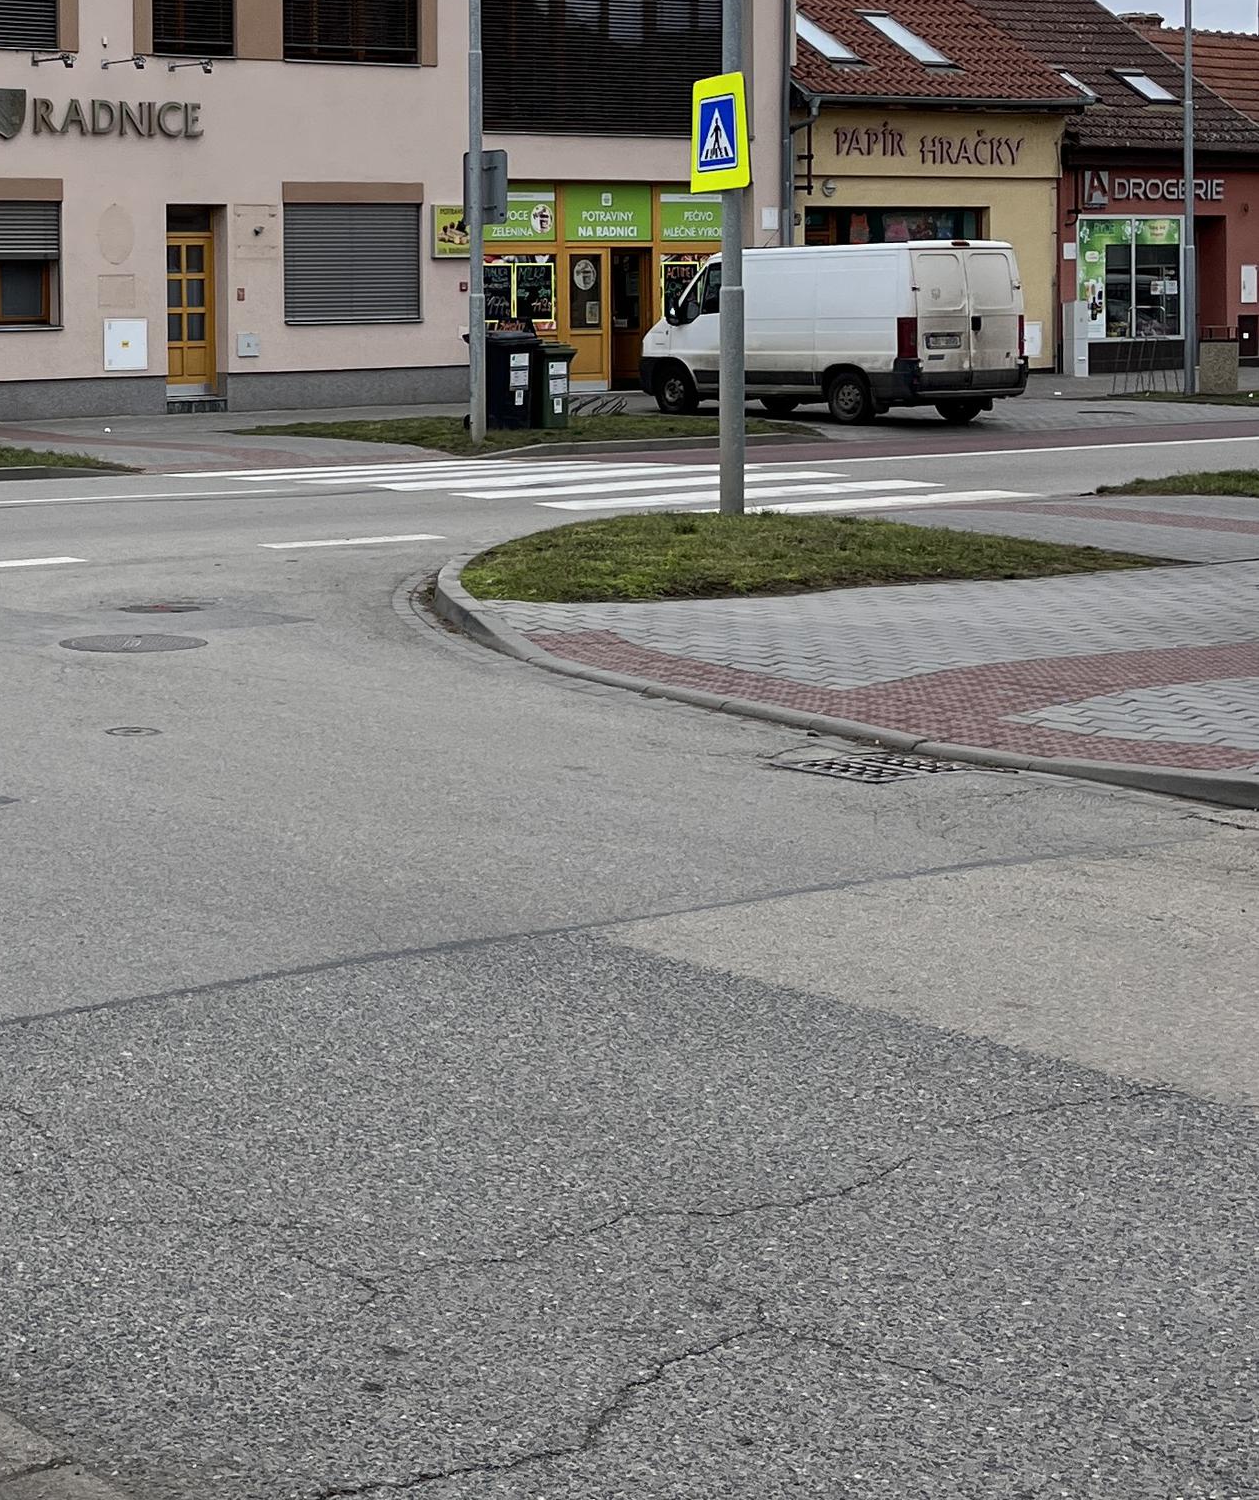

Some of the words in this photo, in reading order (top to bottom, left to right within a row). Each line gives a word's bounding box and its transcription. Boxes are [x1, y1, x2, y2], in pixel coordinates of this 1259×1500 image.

[32, 97, 205, 139] RADNICE
[834, 120, 906, 157] PAPÍR
[920, 129, 1025, 166] HRAČKY
[581, 210, 634, 222] POTRAVINY
[683, 208, 713, 222] PEČIVO
[578, 226, 594, 237] NA
[596, 226, 637, 237] RADNICI
